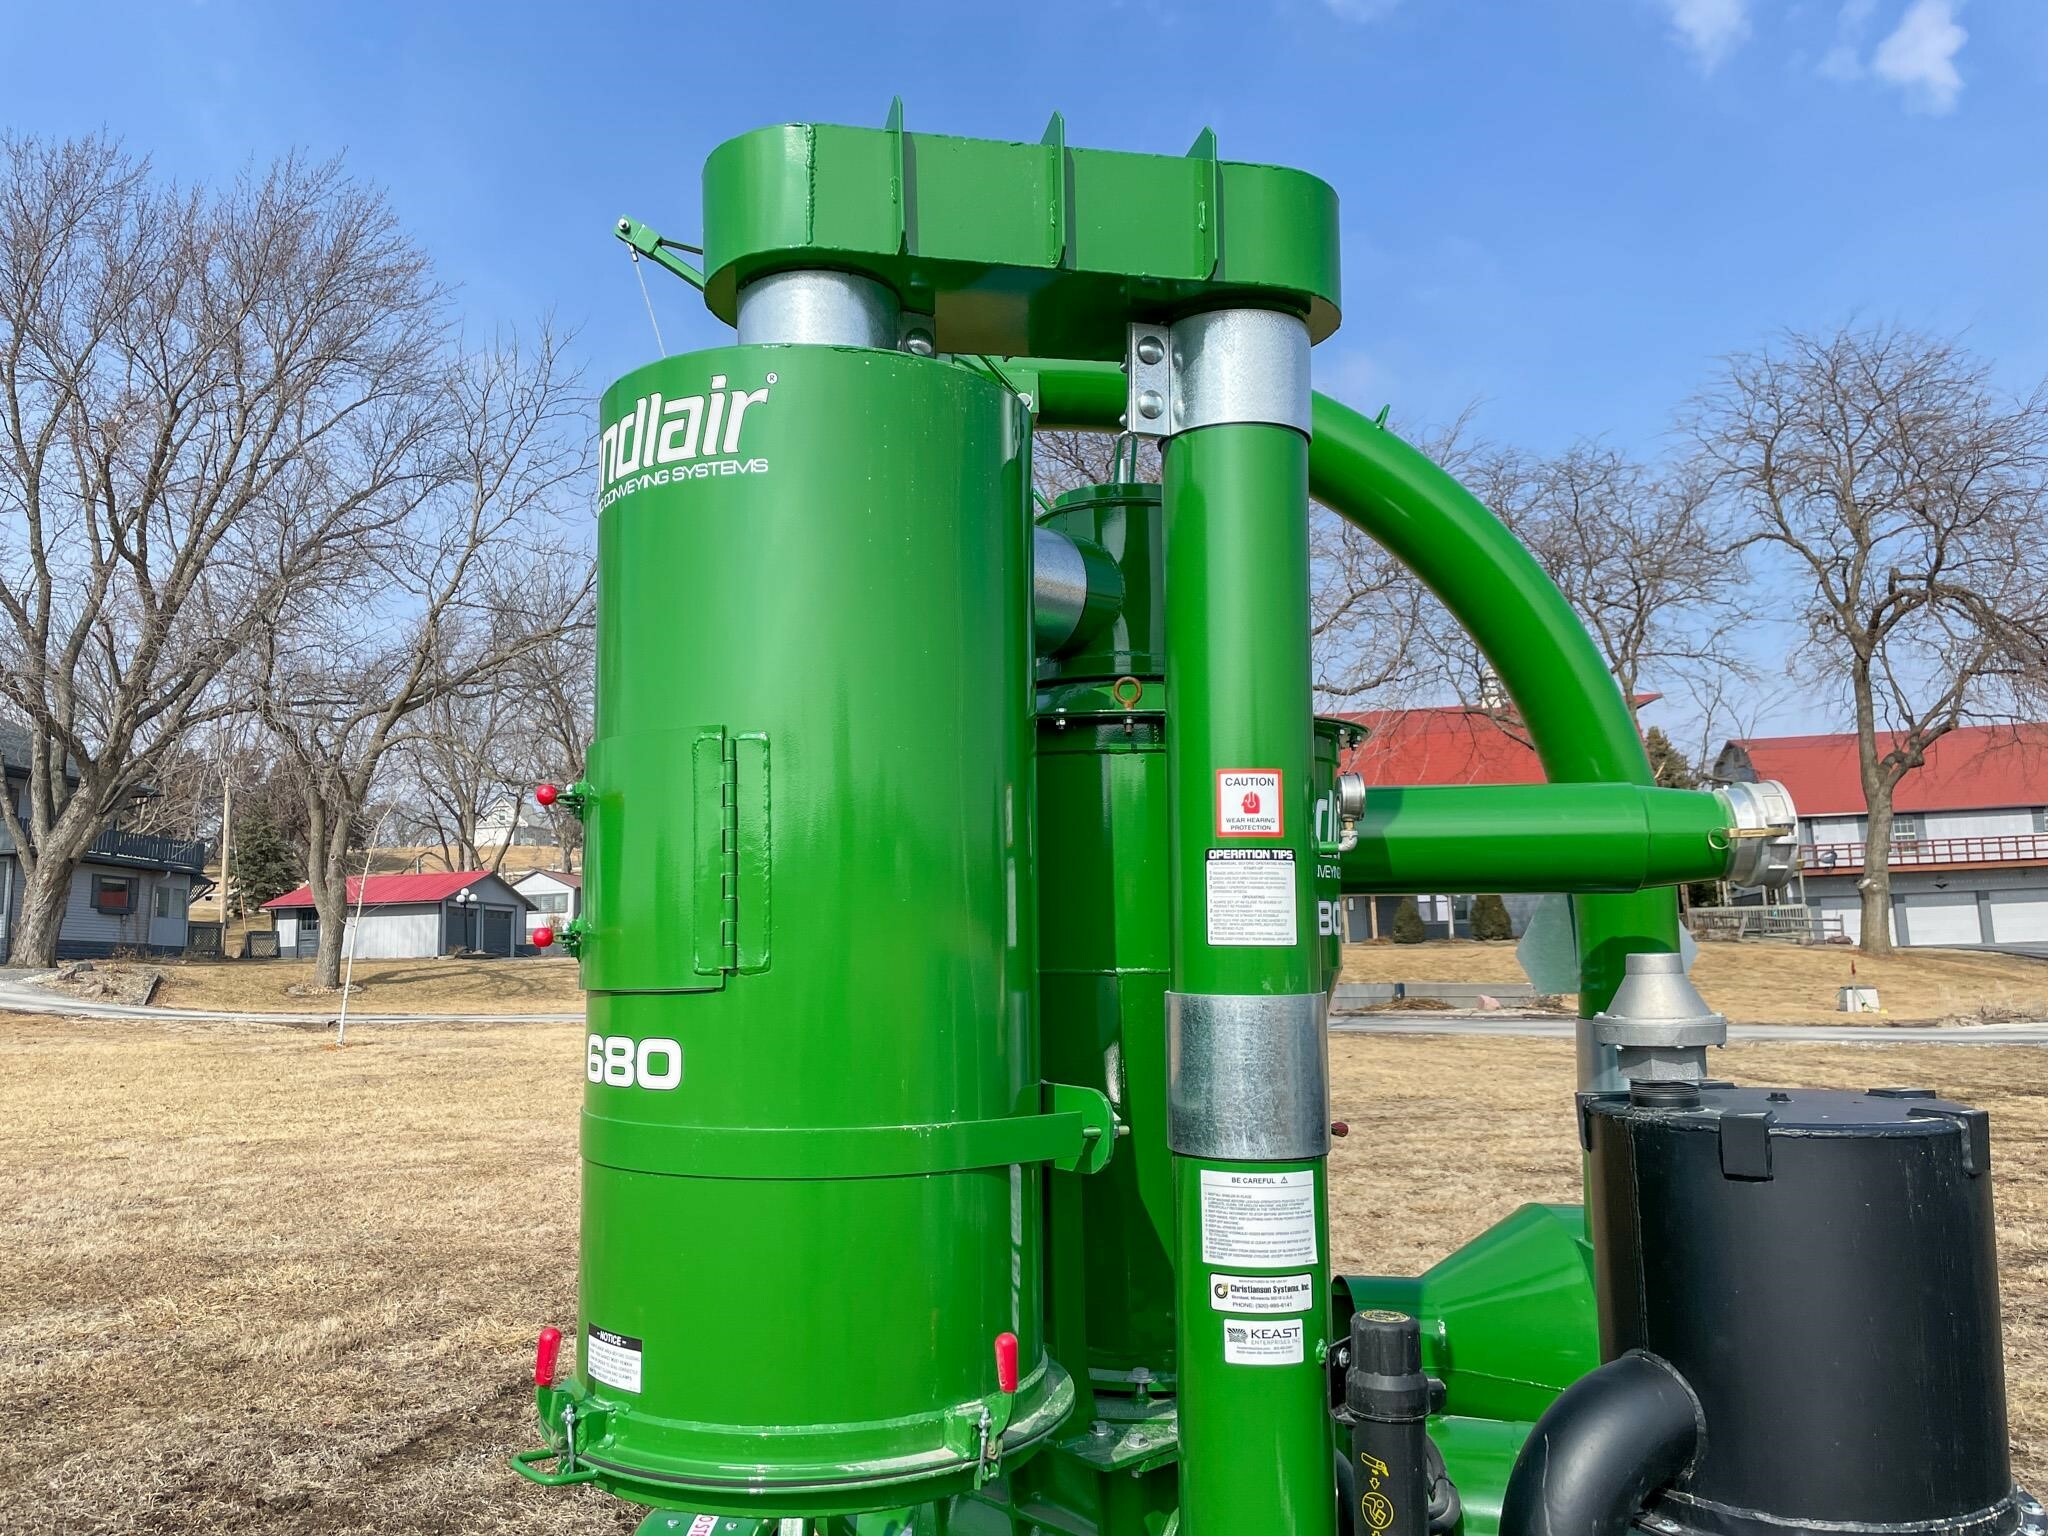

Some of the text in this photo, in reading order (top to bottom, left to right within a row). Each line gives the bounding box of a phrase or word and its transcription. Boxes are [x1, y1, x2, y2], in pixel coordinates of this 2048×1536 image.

[604, 470, 670, 508] CONVEYING
[672, 458, 769, 482] SYSTEMS
[1225, 777, 1275, 787] CAUTION
[1208, 849, 1293, 861] OPERATION TIPS
[588, 1033, 682, 1090] 680
[1231, 1176, 1275, 1185] BE CAREFUL
[1230, 1284, 1271, 1294] Christianson
[1250, 1327, 1300, 1339] KEAST
